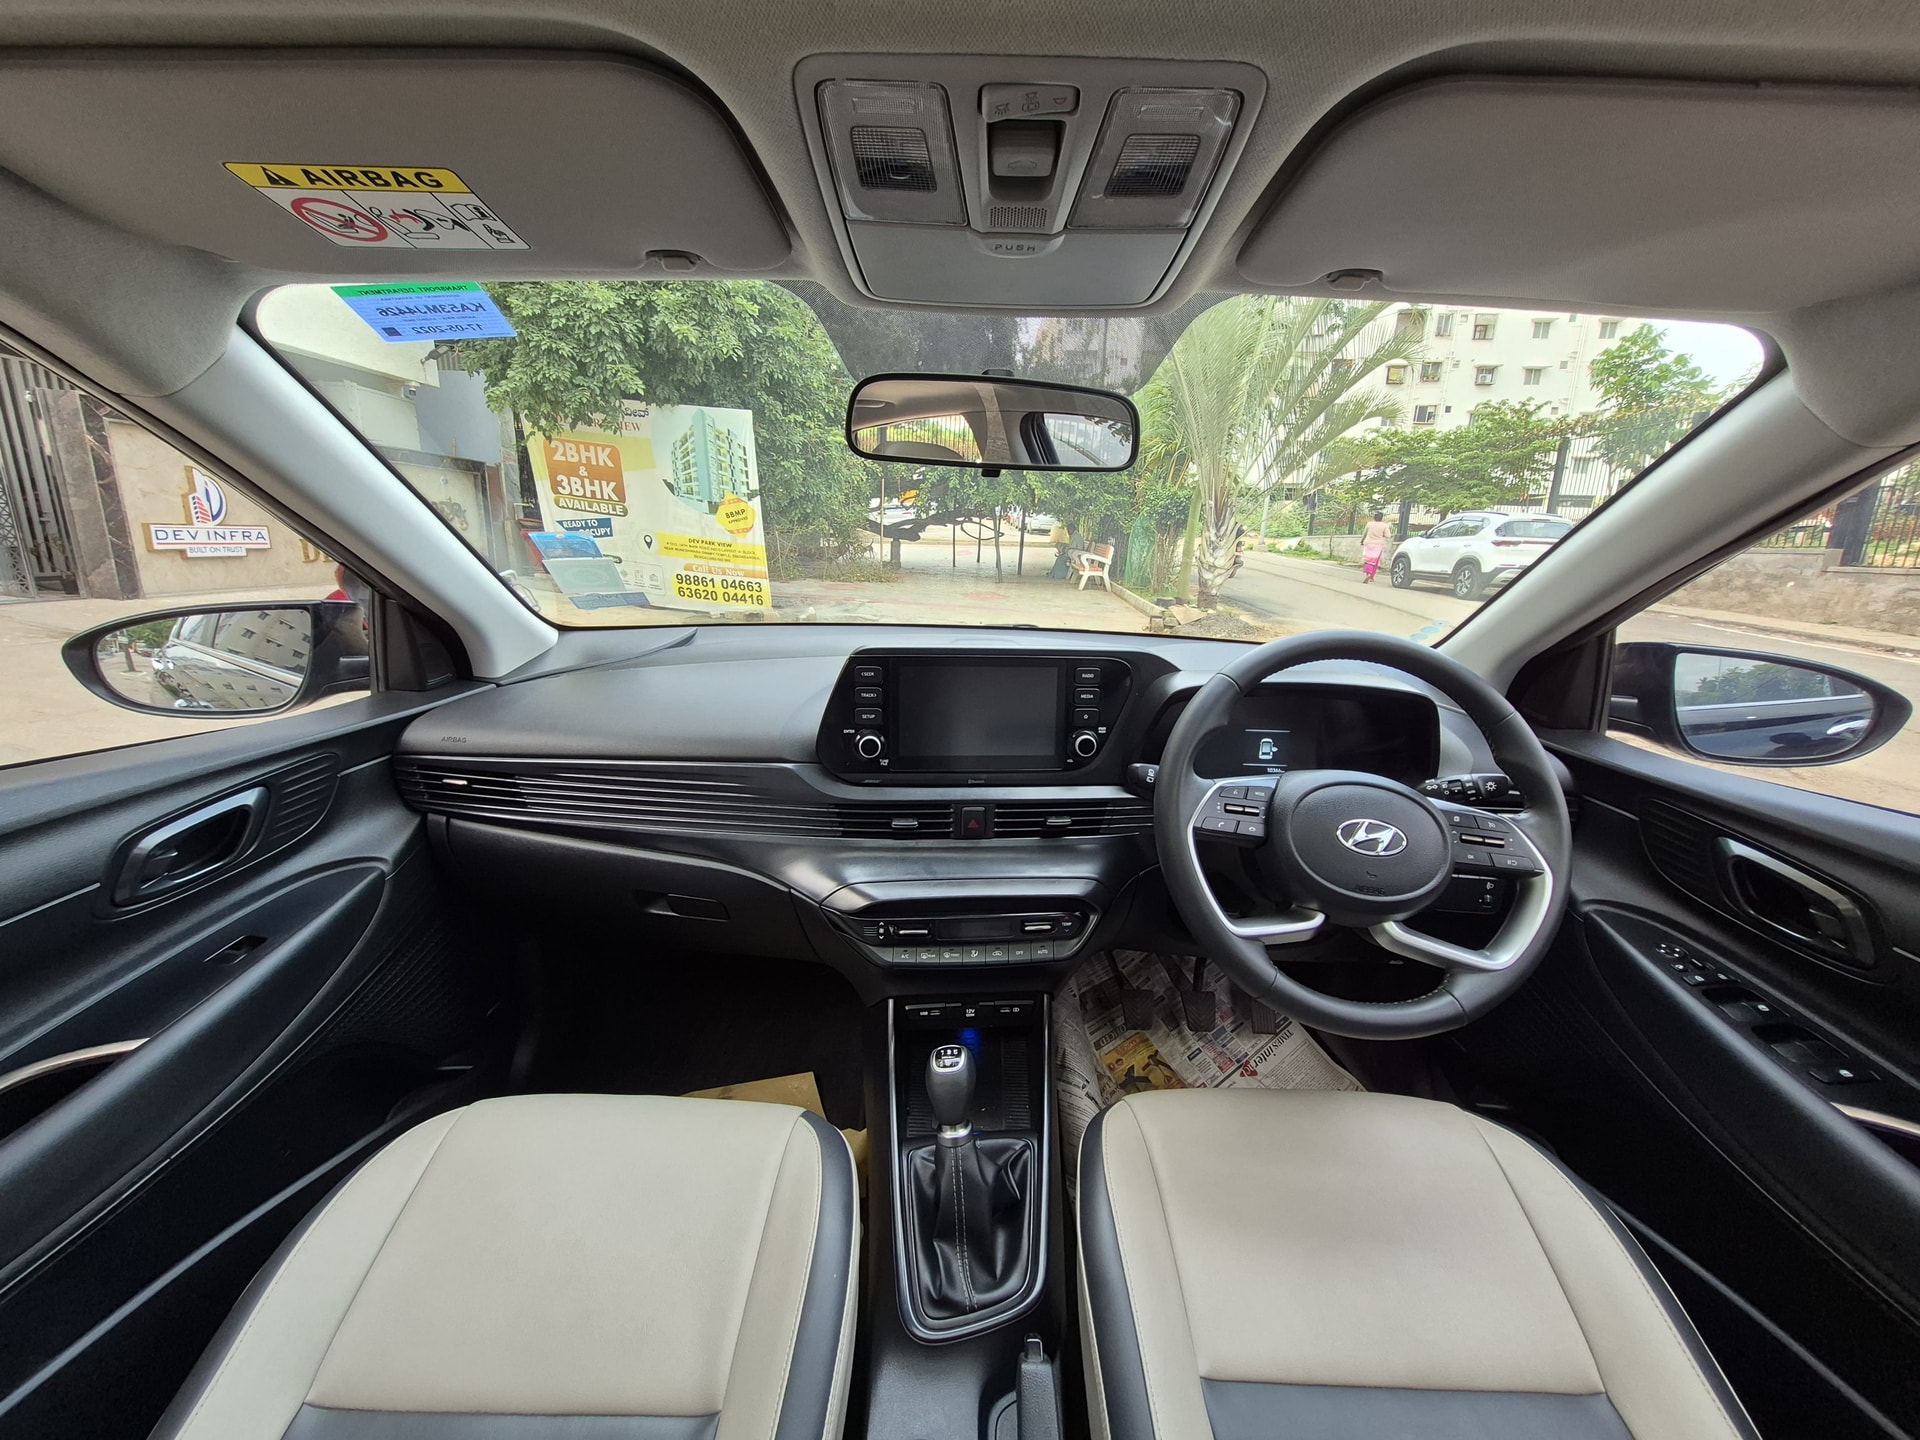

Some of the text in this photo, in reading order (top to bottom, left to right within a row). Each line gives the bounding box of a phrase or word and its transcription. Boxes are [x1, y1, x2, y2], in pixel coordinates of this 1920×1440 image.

[300, 168, 444, 188] AIRBAG
[994, 243, 1036, 252] PUSH
[550, 440, 615, 468] 2BHK
[578, 466, 588, 477] &
[556, 474, 620, 501] 3BHK
[559, 497, 625, 516] AVAILABLE
[725, 508, 746, 519] BBMP
[562, 519, 598, 528] READY TO
[154, 529, 267, 541] DEV INFRA
[189, 546, 244, 554] BUILT ON TRUST
[692, 564, 745, 577] Call Us Now
[675, 573, 716, 589] 98861
[721, 578, 763, 593] 04663
[677, 586, 718, 601] 63620
[722, 591, 764, 606] 04416
[441, 736, 468, 744] AIRBAG
[1273, 1028, 1295, 1050] TIMES
